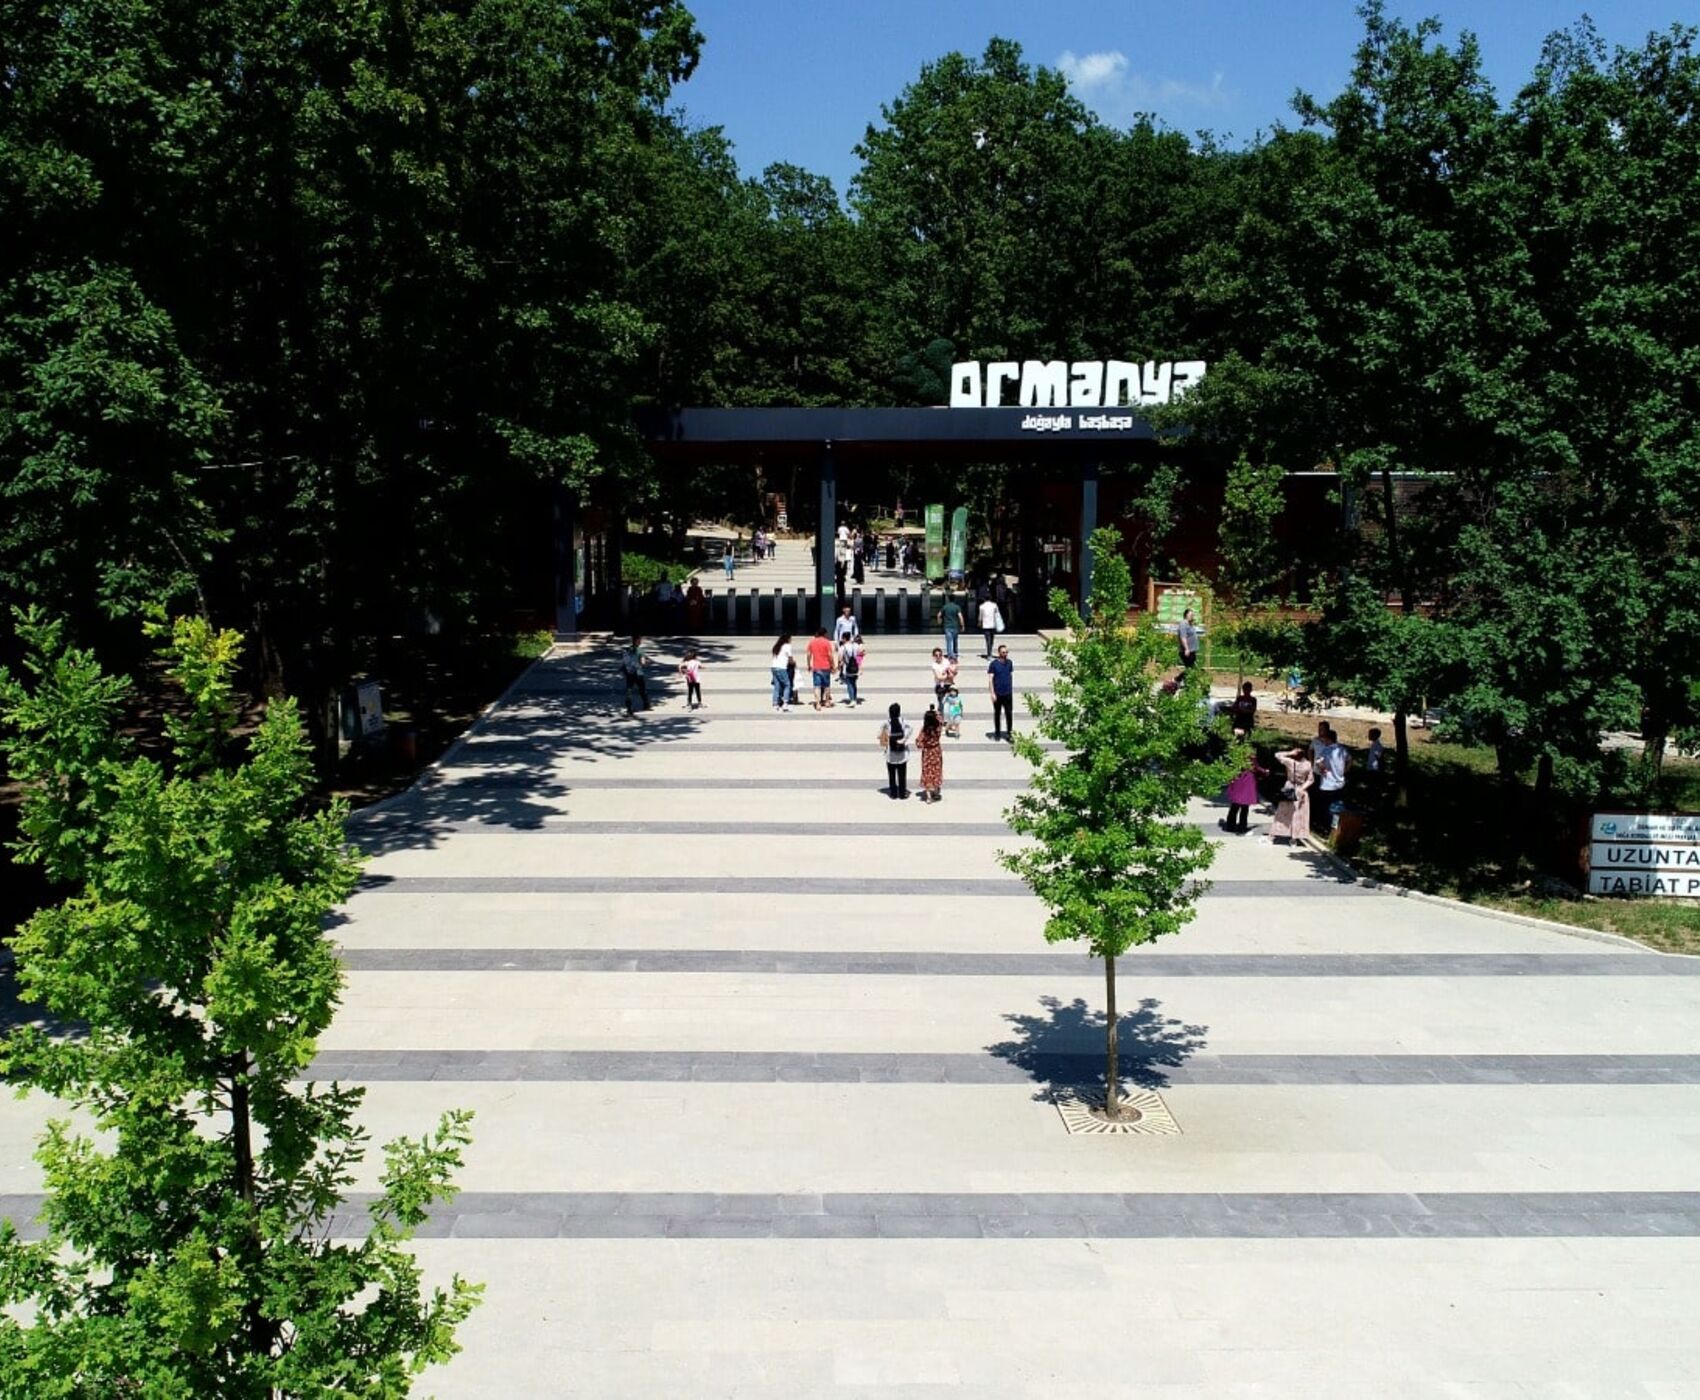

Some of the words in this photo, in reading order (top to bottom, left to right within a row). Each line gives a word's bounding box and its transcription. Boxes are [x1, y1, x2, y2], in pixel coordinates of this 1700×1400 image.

[1021, 414, 1072, 431] doğayla
[1078, 414, 1133, 430] başbaşa
[1607, 848, 1700, 865] UZUNTA
[1600, 874, 1680, 893] TABİAT
